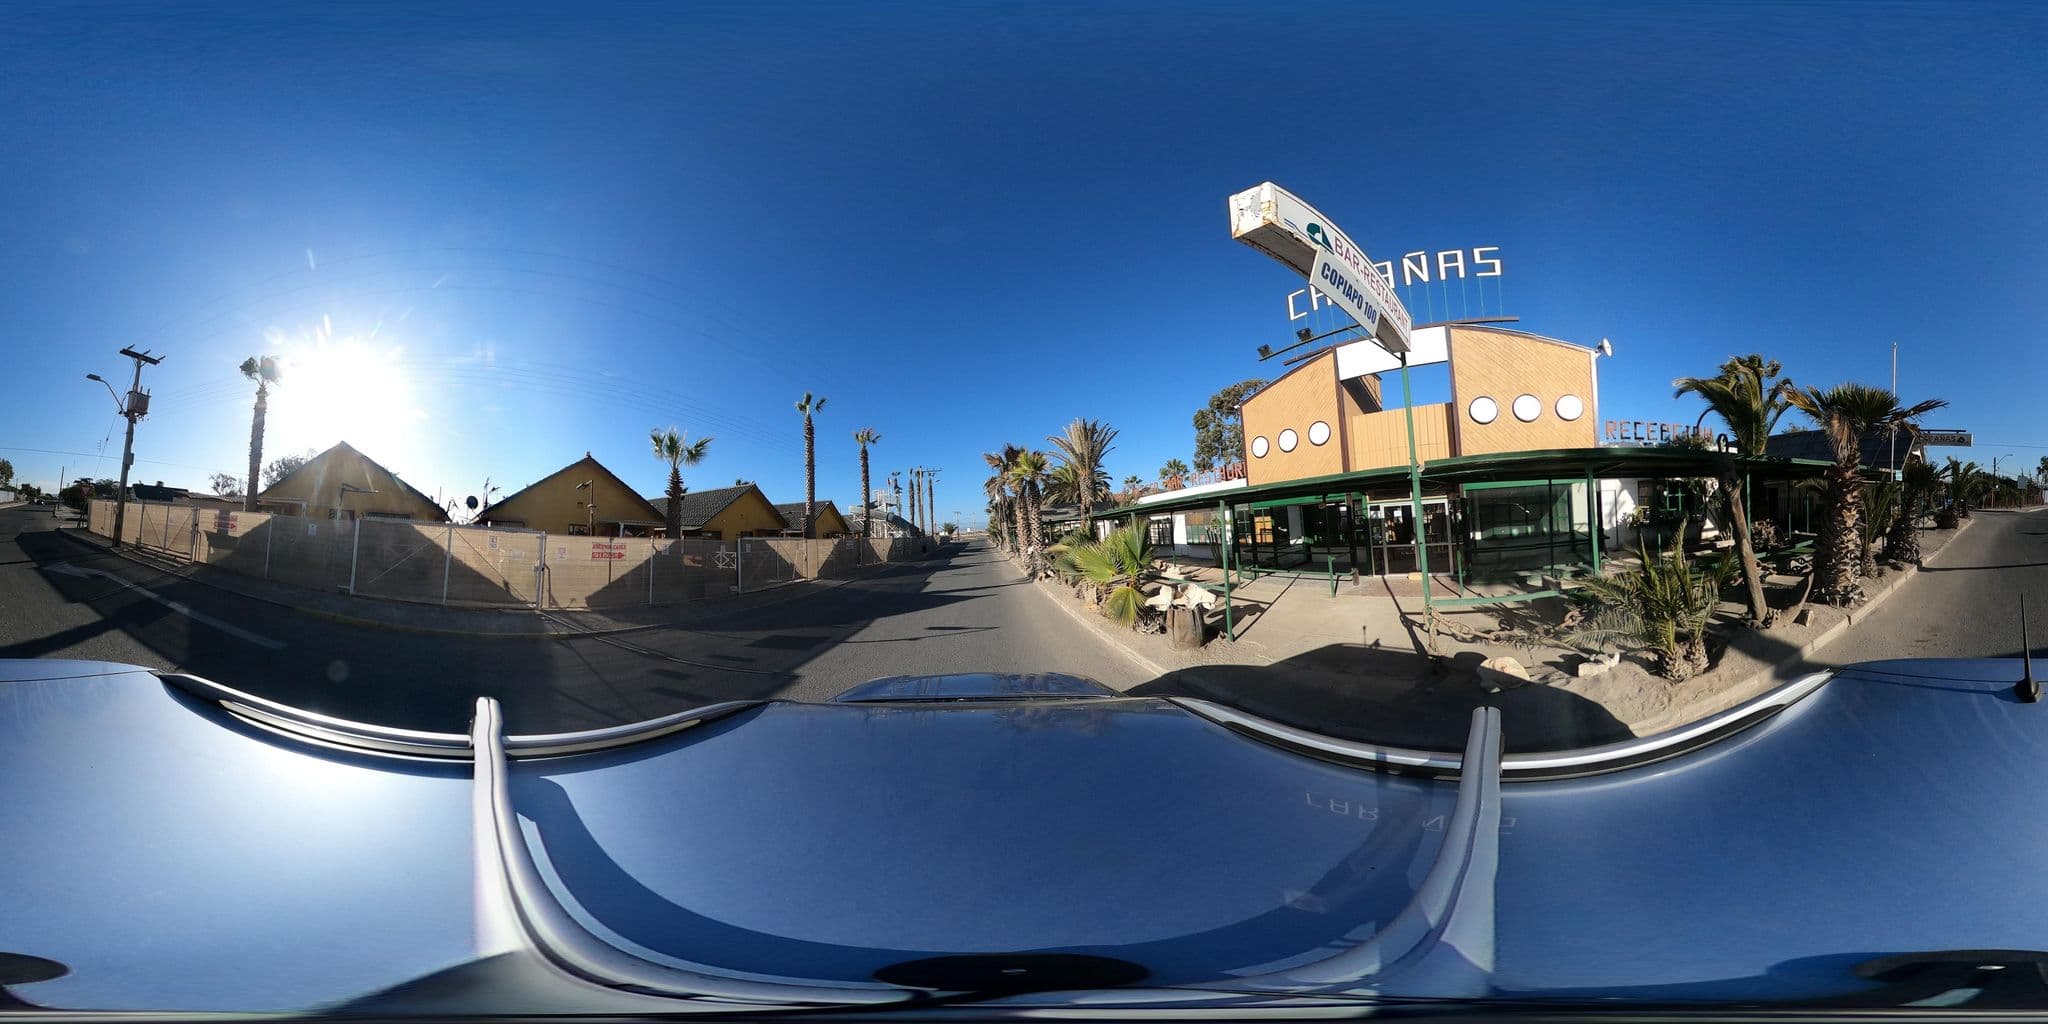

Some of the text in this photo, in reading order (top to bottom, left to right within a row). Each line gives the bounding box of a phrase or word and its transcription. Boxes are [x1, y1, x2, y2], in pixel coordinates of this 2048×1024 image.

[1288, 247, 1502, 321] CAAÑAS
[1321, 262, 1377, 324] COPIAPO 100
